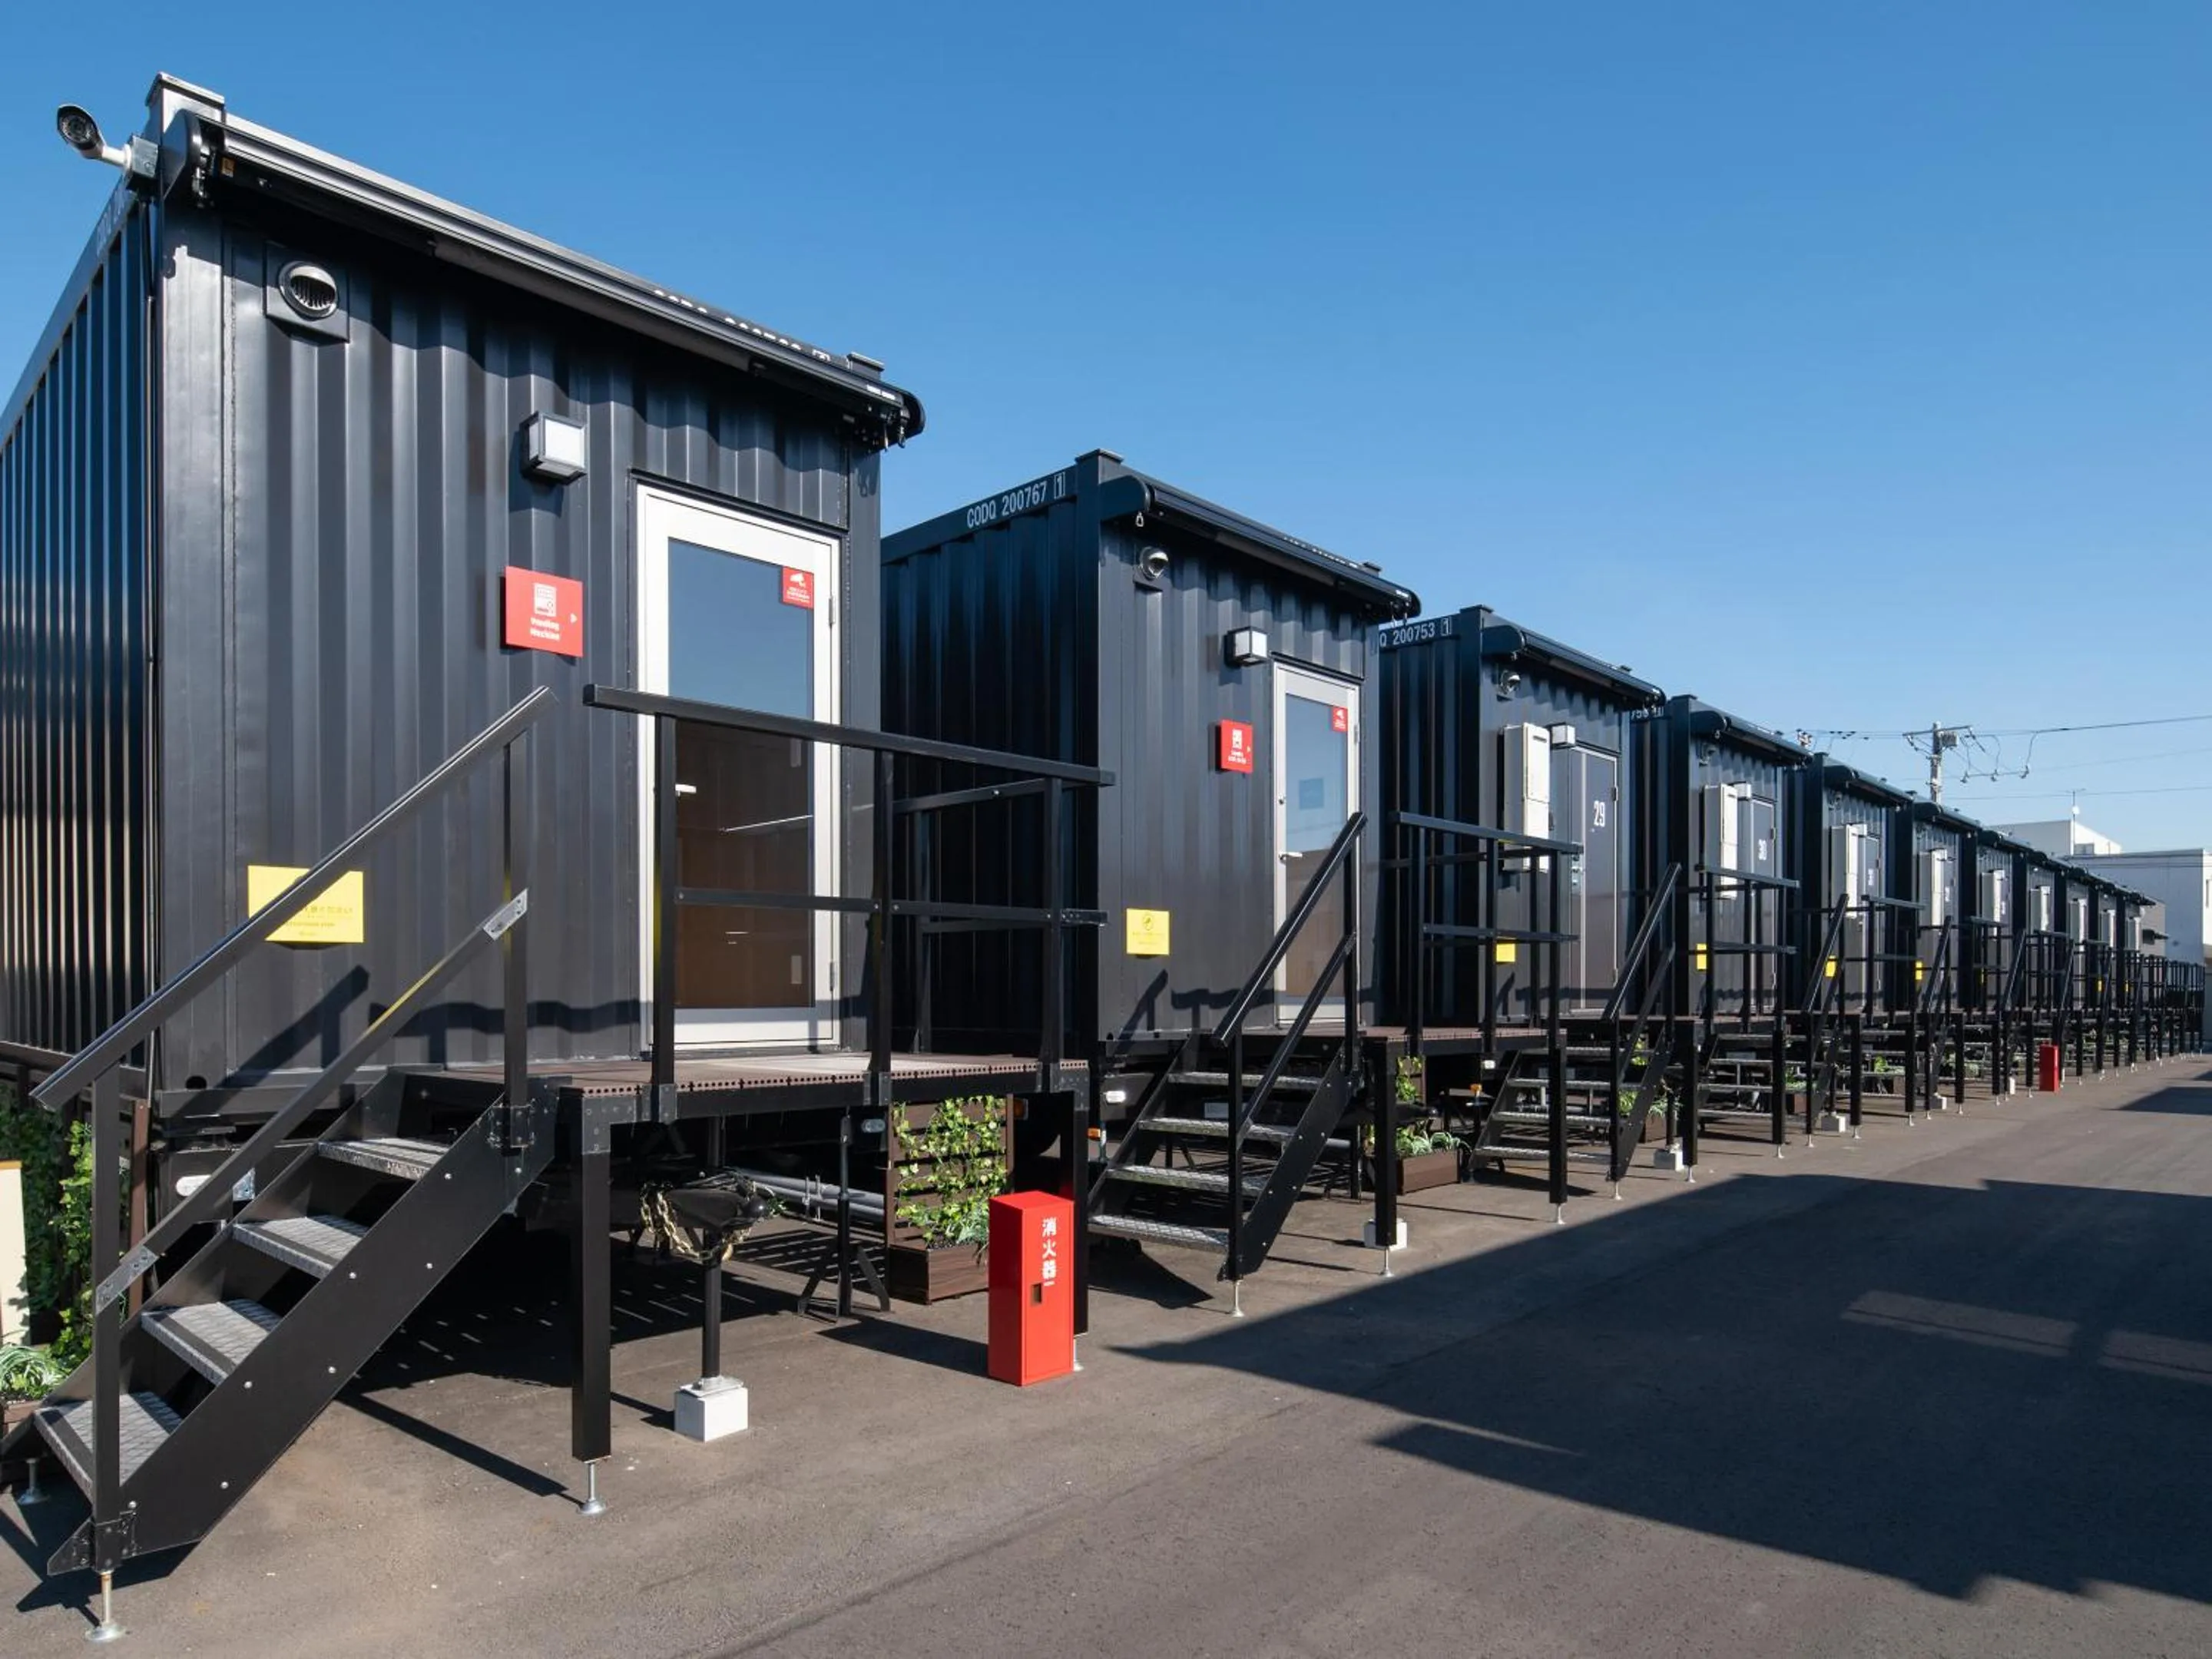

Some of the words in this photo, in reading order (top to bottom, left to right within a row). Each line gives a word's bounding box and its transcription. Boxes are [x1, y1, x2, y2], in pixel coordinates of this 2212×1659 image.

[1002, 481, 1047, 516] 200767
[1392, 622, 1435, 645] 200753
[1594, 800, 1605, 827] 29
[1042, 1217, 1057, 1280] 消火器
